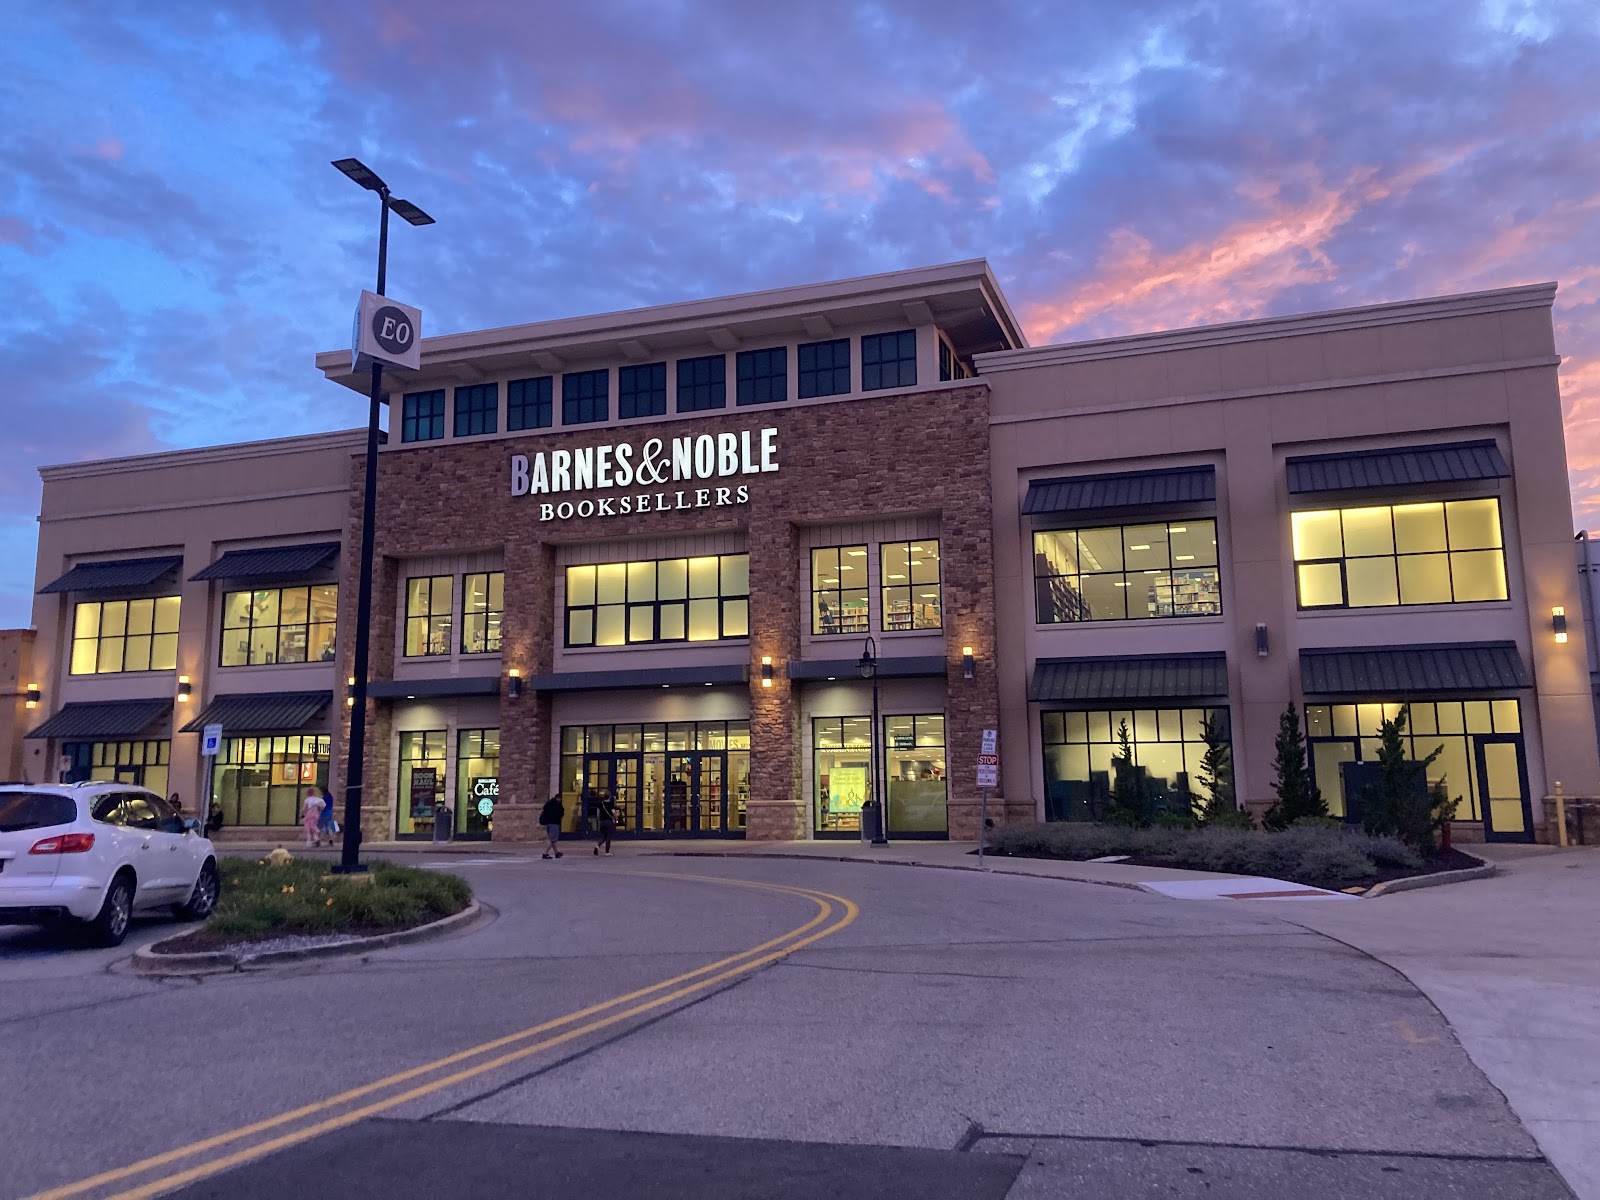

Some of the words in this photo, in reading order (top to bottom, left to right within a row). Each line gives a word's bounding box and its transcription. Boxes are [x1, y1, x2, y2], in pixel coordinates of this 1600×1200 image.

[540, 485, 749, 522] BOOKSELLERS
[979, 755, 997, 765] STOP
[474, 783, 500, 796] Café
